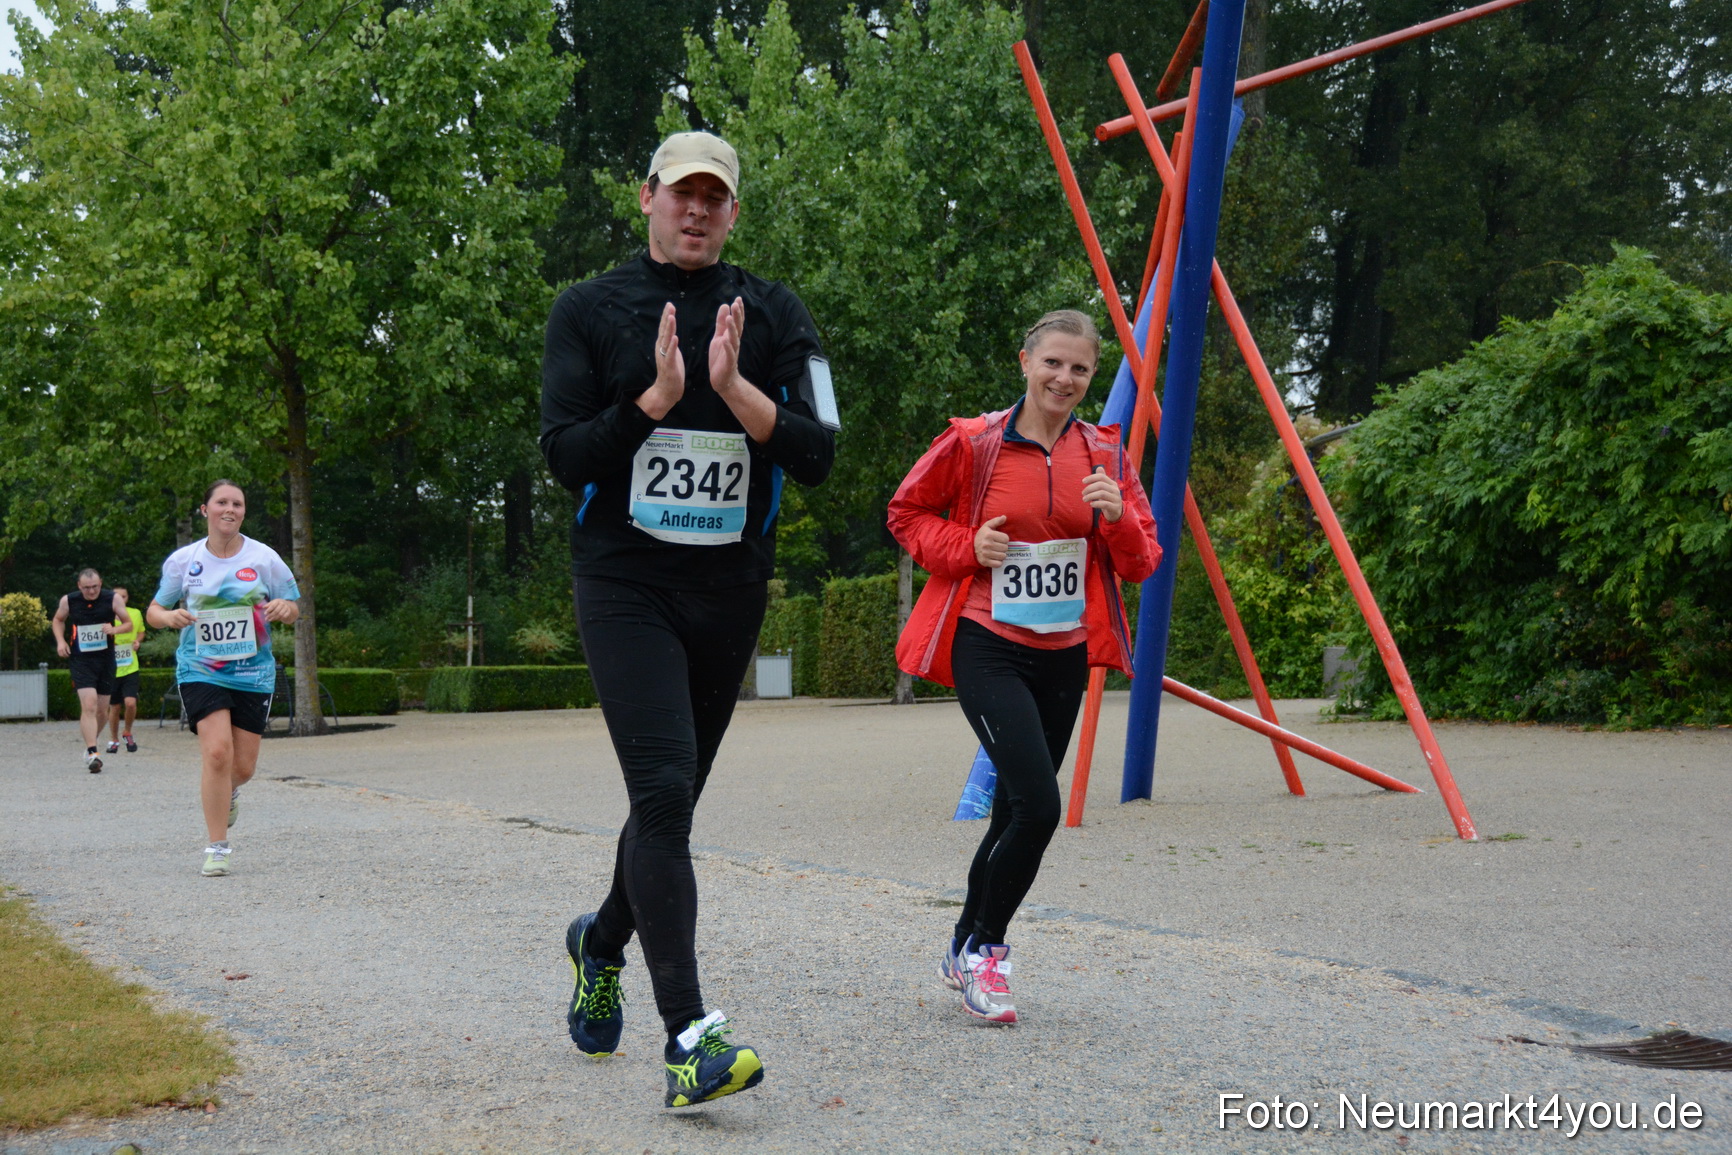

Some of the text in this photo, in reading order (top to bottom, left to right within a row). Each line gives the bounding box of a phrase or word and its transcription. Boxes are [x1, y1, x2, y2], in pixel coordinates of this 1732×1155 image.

[645, 441, 684, 449] NeuerMarkt
[691, 435, 746, 451] BOCK
[645, 456, 744, 501] 2342
[660, 510, 723, 529] Andreas
[1037, 542, 1080, 555] BOCK
[1003, 562, 1078, 598] 3036
[81, 630, 105, 642] 2647
[200, 620, 249, 642] 3027
[209, 642, 247, 656] SARAH
